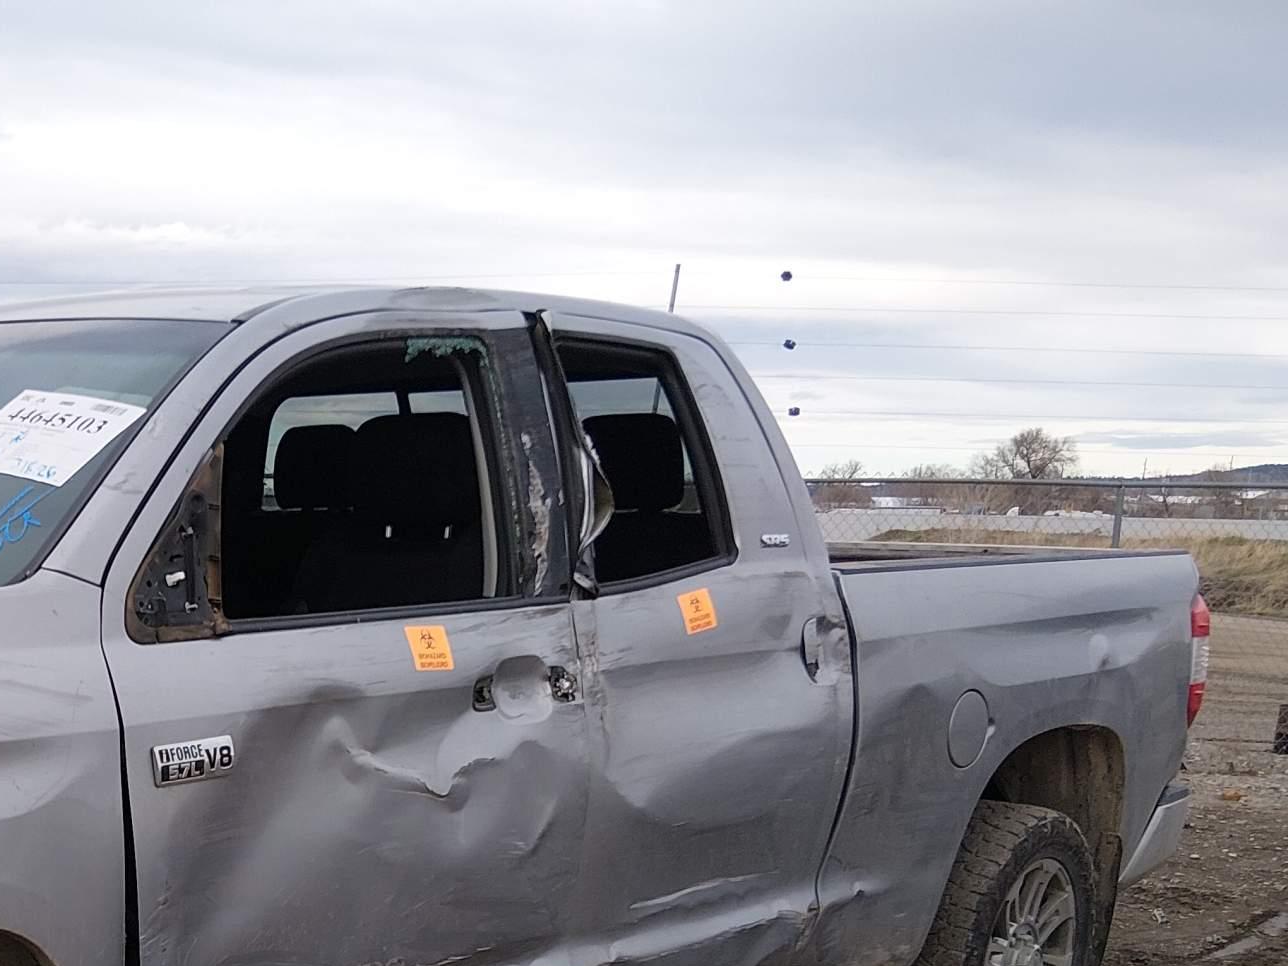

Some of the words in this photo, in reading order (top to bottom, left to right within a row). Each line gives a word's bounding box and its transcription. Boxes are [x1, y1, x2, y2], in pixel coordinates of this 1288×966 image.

[8, 407, 108, 434] 44645103
[205, 746, 232, 770] V8
[168, 761, 201, 780] 5.7L
